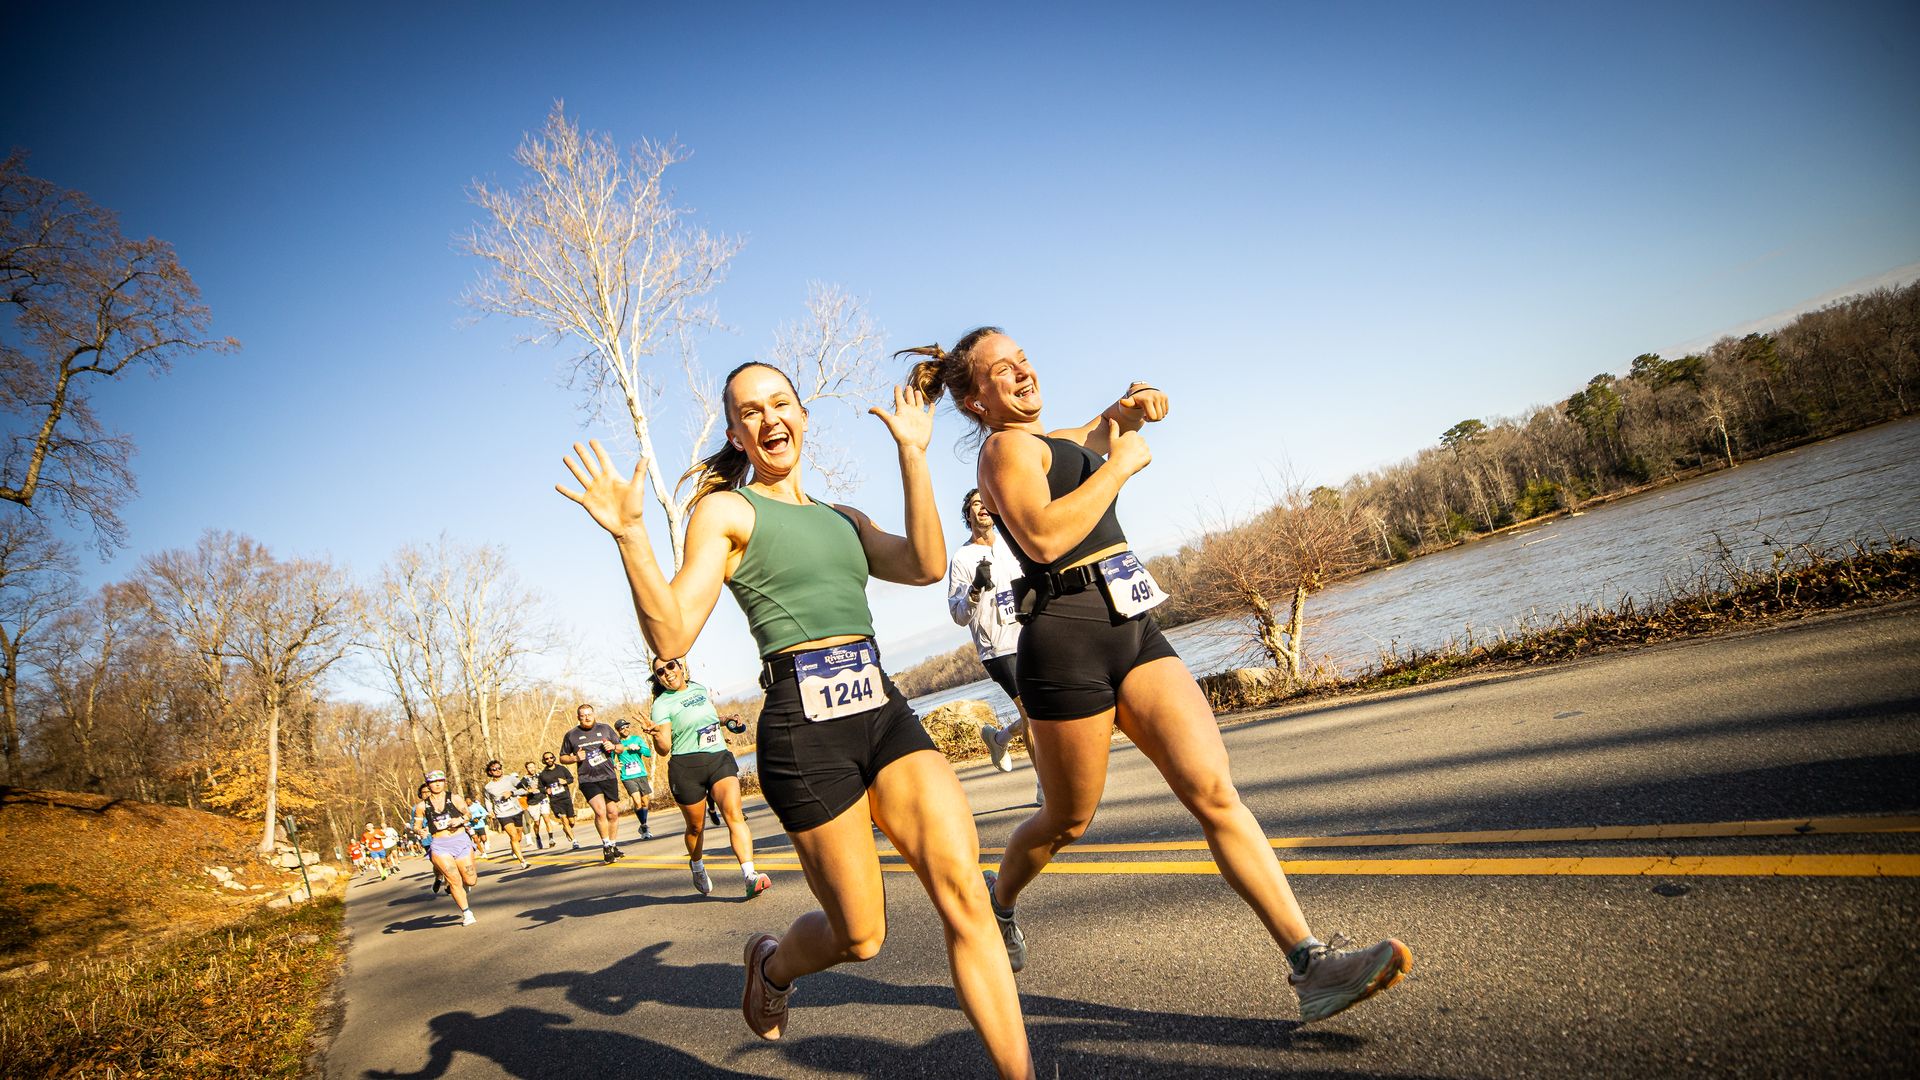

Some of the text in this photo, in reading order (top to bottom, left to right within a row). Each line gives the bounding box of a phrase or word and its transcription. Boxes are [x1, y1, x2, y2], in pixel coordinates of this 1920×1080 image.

[1004, 606, 1015, 615] 10
[824, 654, 845, 665] River
[820, 677, 873, 708] 1244
